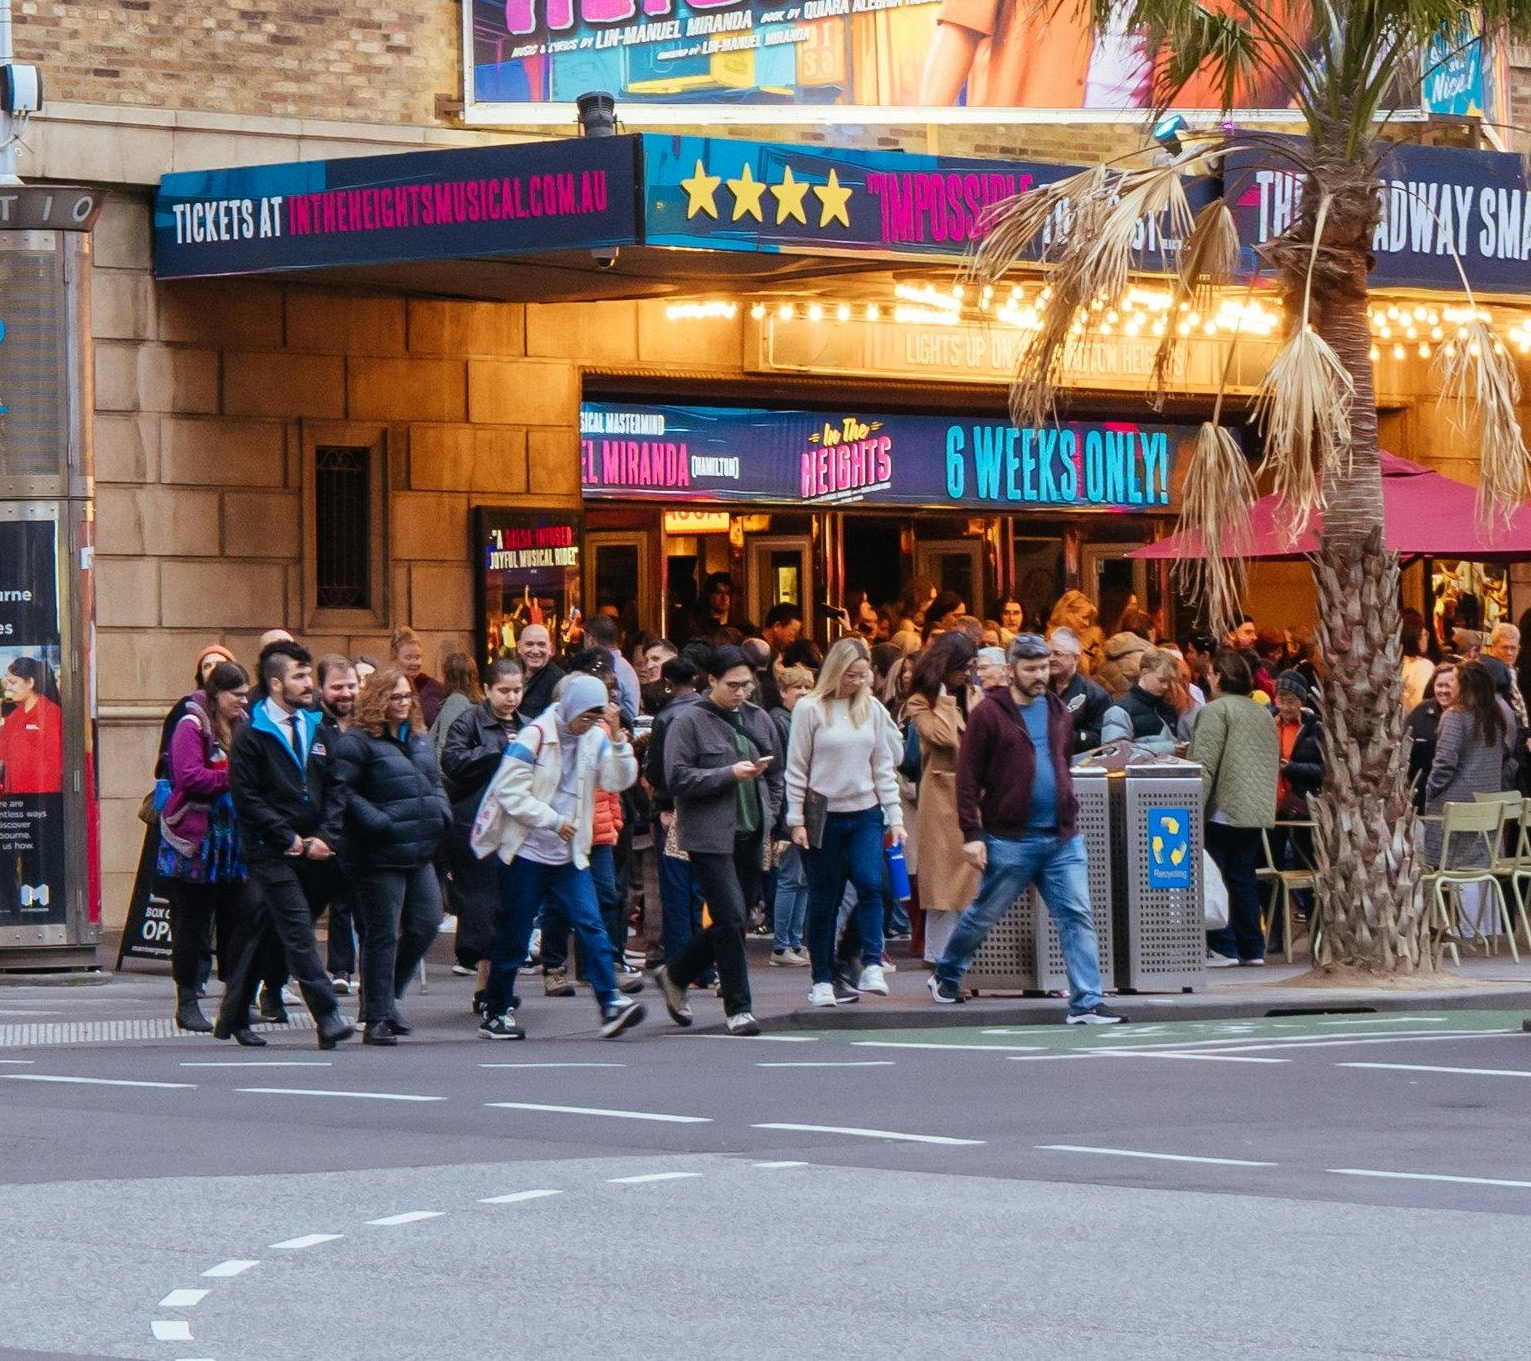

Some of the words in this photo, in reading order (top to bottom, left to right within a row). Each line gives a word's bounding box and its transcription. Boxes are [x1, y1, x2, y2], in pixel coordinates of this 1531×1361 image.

[595, 20, 682, 49] LIN-MANUEL
[686, 10, 754, 37] MIRANDA
[172, 199, 255, 245] TICKETS
[259, 196, 284, 238] AT
[287, 170, 608, 237] INTHEHEIGHTSMUSICAL.COM.AU
[866, 172, 1033, 244] "IMPOSSI
[1255, 170, 1307, 243] THE
[1372, 179, 1475, 257] ADWAY
[905, 333, 961, 368] LIGHTS
[965, 335, 987, 368] UP
[991, 338, 1012, 370] ON
[606, 413, 665, 436] MASTERMIND
[823, 422, 841, 447] In
[842, 417, 869, 443] The
[602, 440, 690, 487] MIRANDA
[801, 435, 891, 498] HEIGHTS
[946, 425, 965, 500] 6
[973, 426, 1078, 503] WEEKS
[1086, 430, 1169, 505] ONLY!
[490, 551, 518, 570] JOYFUL
[519, 549, 554, 567] MUSICAL
[26, 811, 47, 820] ways
[1153, 868, 1187, 879] Recycling
[142, 920, 172, 942] OP
[145, 907, 164, 918] BOX
